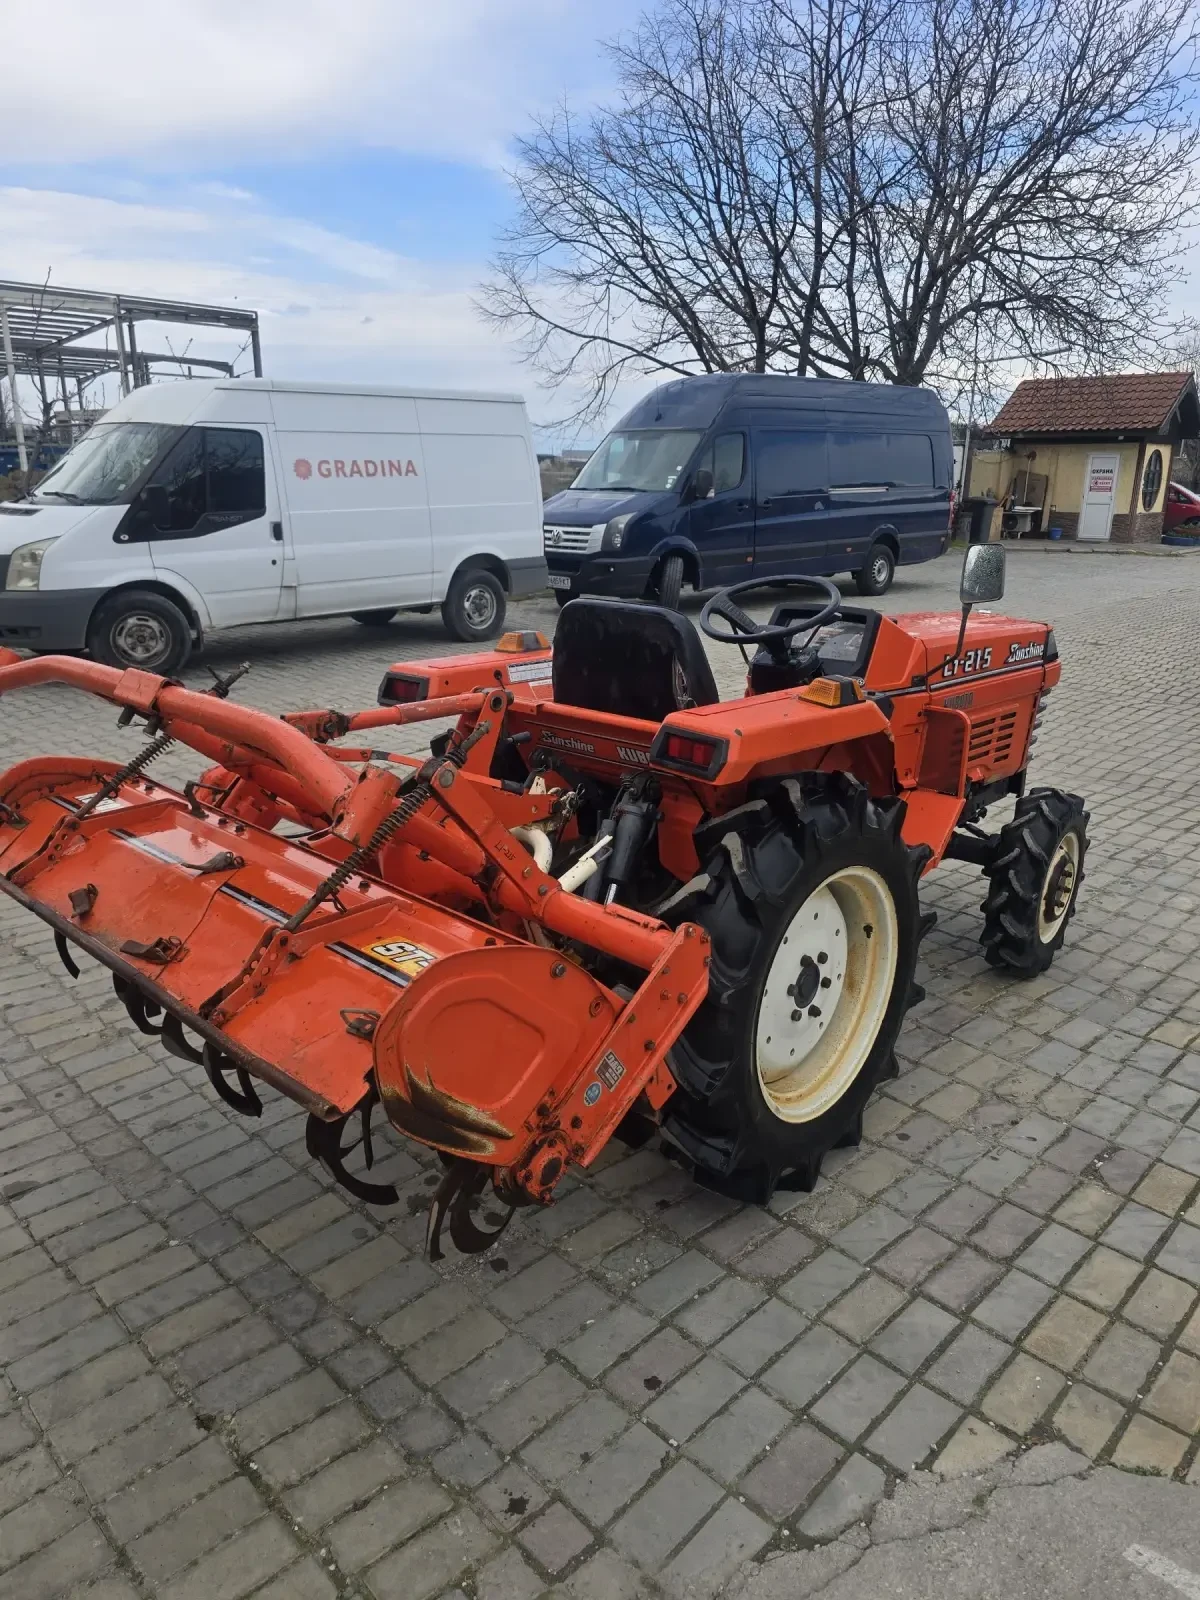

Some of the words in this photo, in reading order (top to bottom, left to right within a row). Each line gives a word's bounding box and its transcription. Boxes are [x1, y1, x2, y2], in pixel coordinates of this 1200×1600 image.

[317, 459, 418, 478] GRADINA
[1006, 642, 1044, 663] Sunshine
[541, 730, 594, 753] Sunshine
